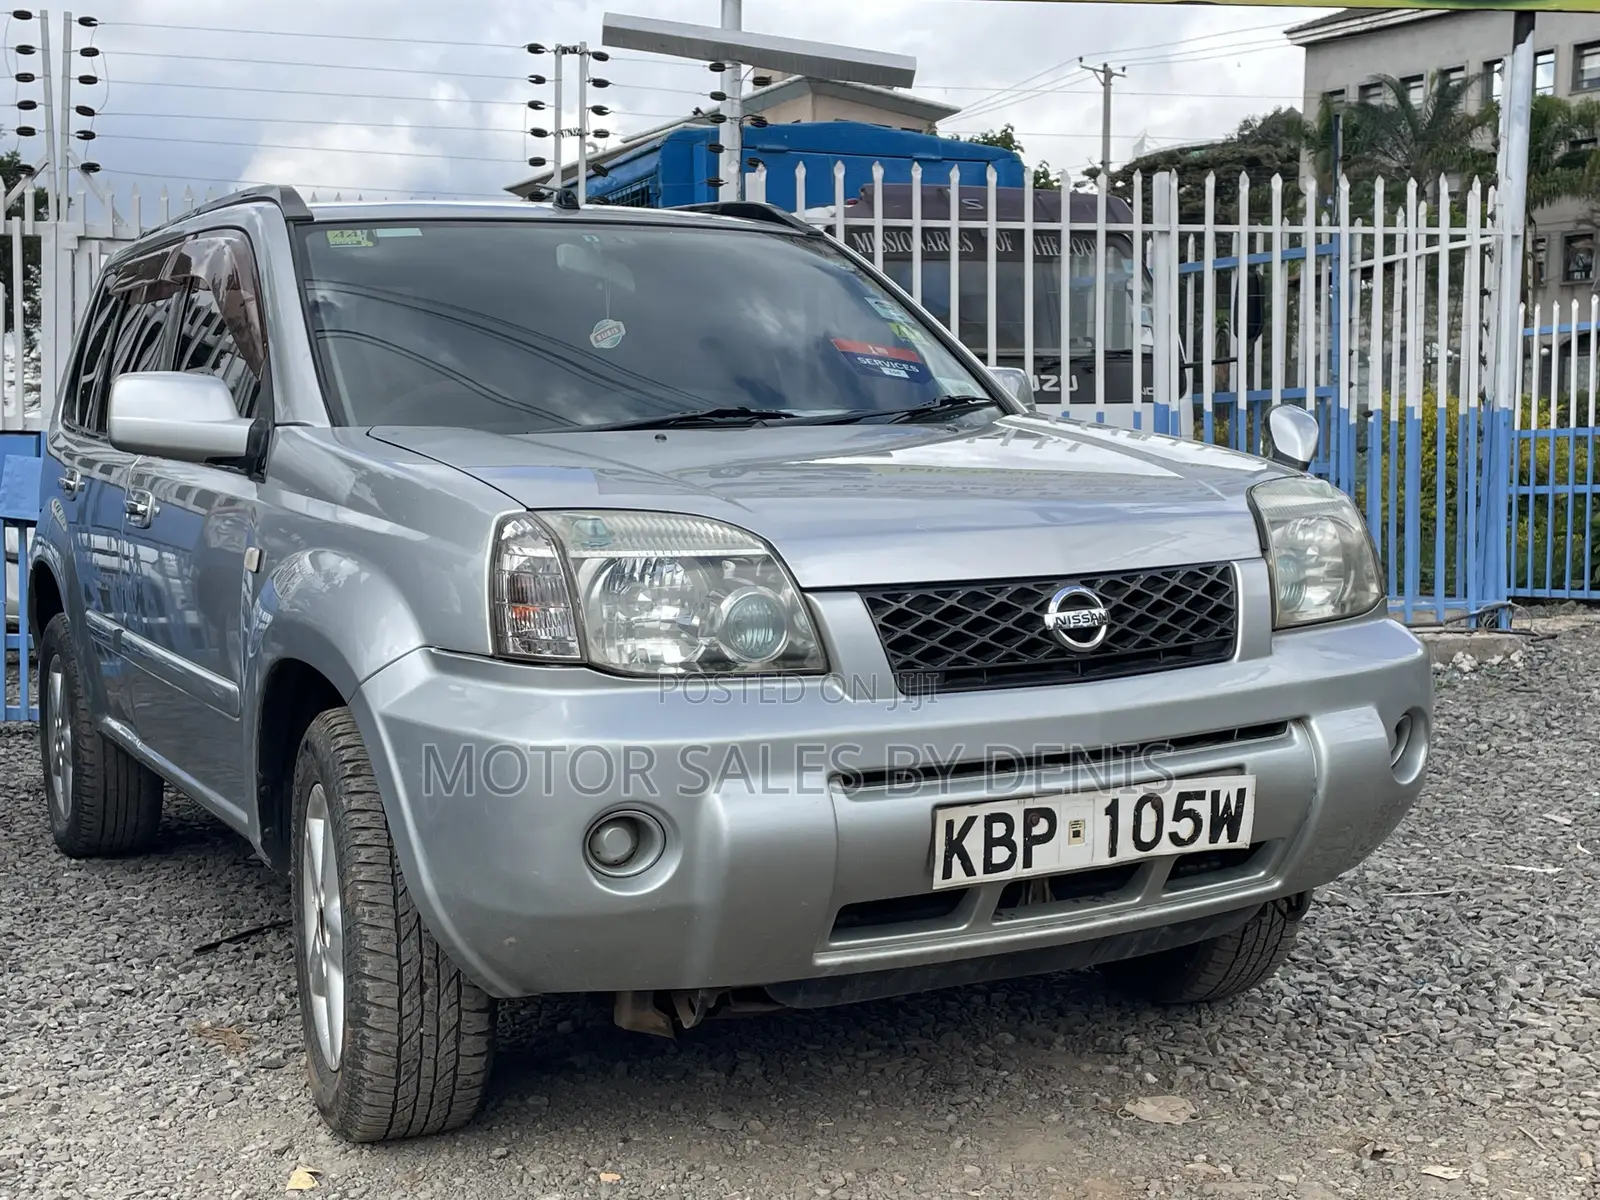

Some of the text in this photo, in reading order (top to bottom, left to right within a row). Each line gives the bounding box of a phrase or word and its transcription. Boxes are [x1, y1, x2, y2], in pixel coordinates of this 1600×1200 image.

[851, 231, 974, 253] MSIOARS
[857, 357, 919, 373] SERVICES
[1055, 612, 1106, 626] NISSAN
[942, 787, 1247, 881] KBP 105W
